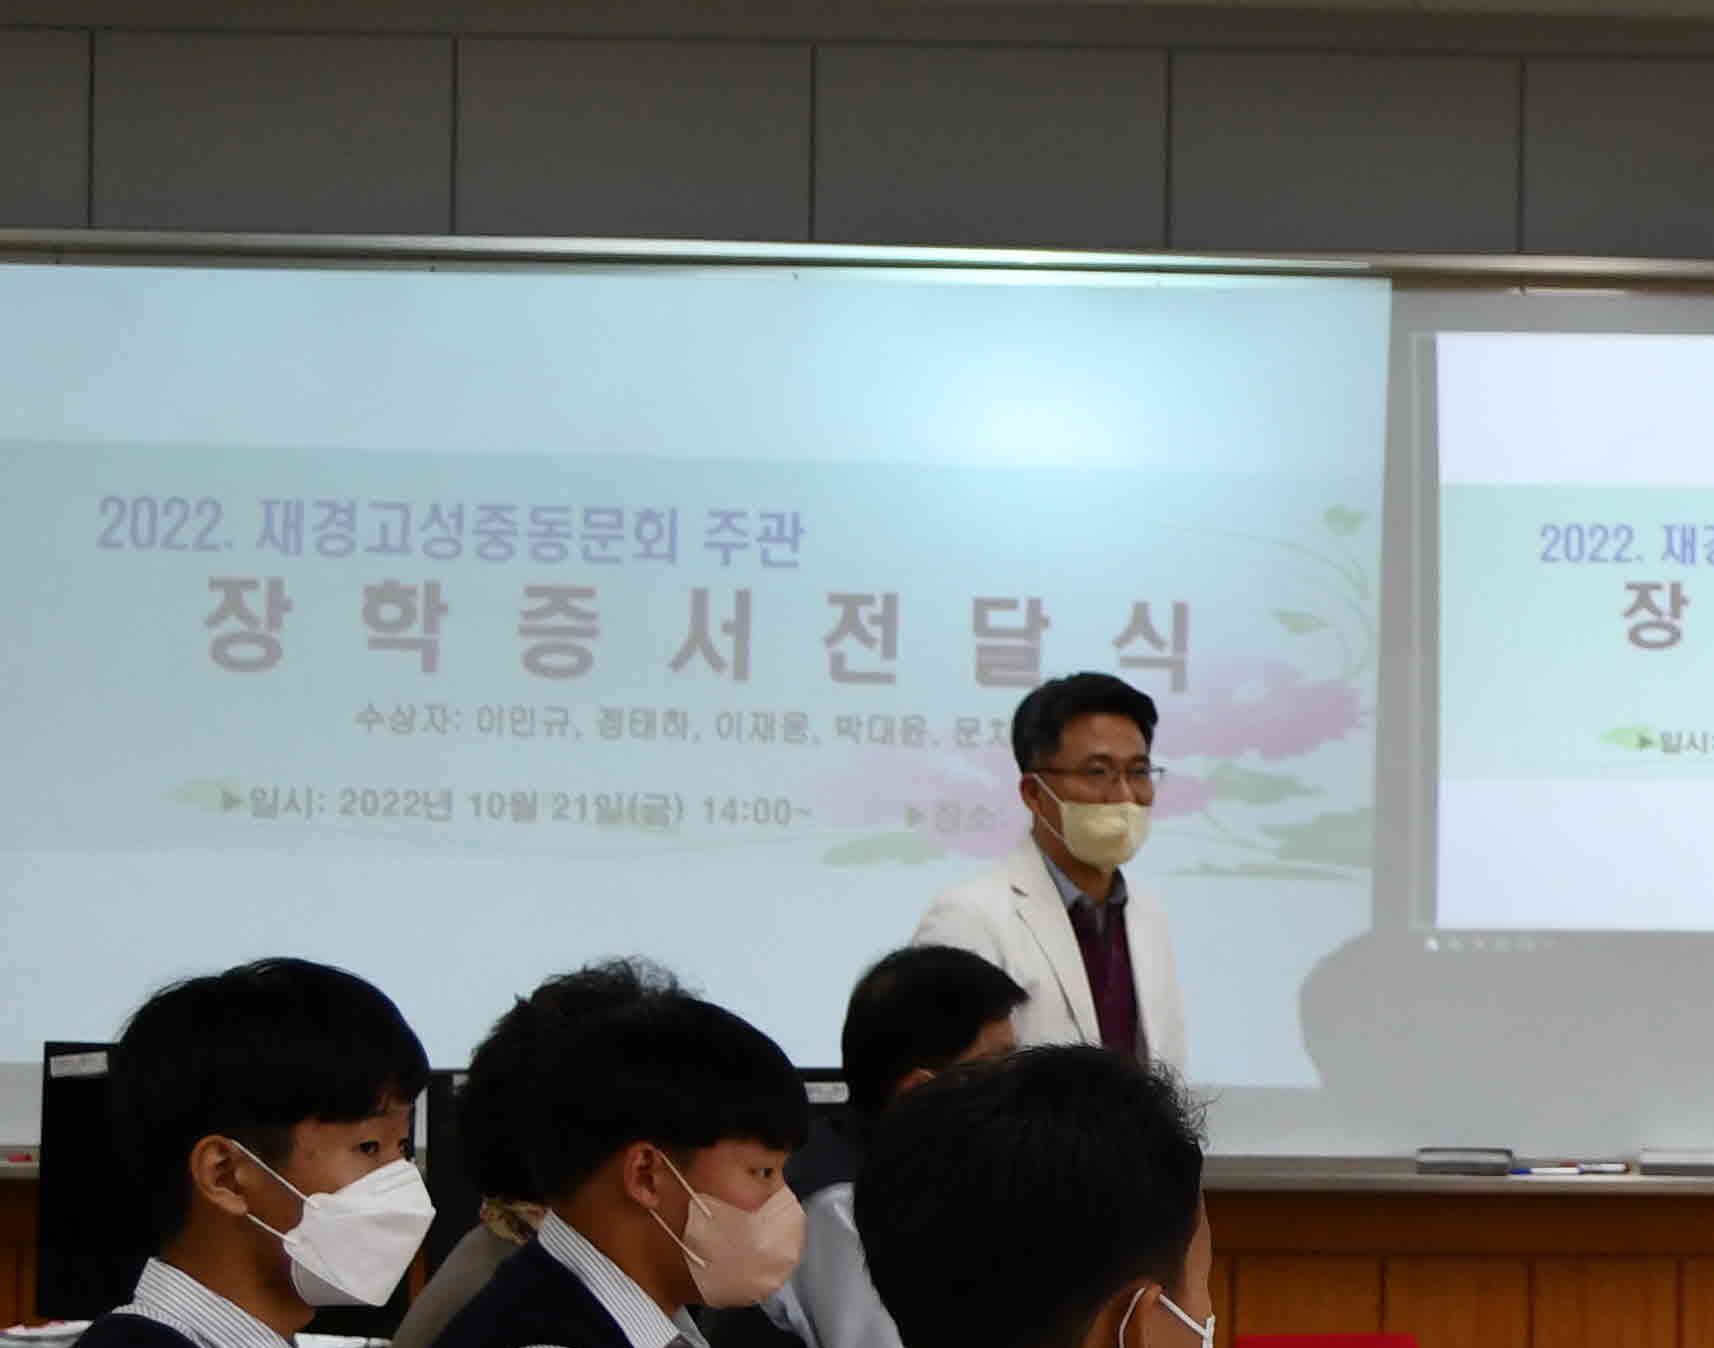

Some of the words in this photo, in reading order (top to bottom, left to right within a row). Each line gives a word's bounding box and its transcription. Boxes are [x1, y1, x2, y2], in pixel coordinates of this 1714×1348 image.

[97, 496, 234, 552] 2022.
[256, 498, 679, 565] 재경고성중동문회
[704, 508, 806, 568] 주관
[1540, 523, 1643, 563] 2022.
[205, 576, 293, 672] 장
[362, 579, 448, 673] 학
[518, 585, 598, 680] 증
[668, 588, 751, 681] 서
[823, 592, 899, 685] 전
[972, 597, 1050, 687] 달
[1111, 600, 1190, 693] 식
[1623, 581, 1690, 650] 장
[337, 787, 451, 823] 2022년
[467, 789, 538, 825] 10월
